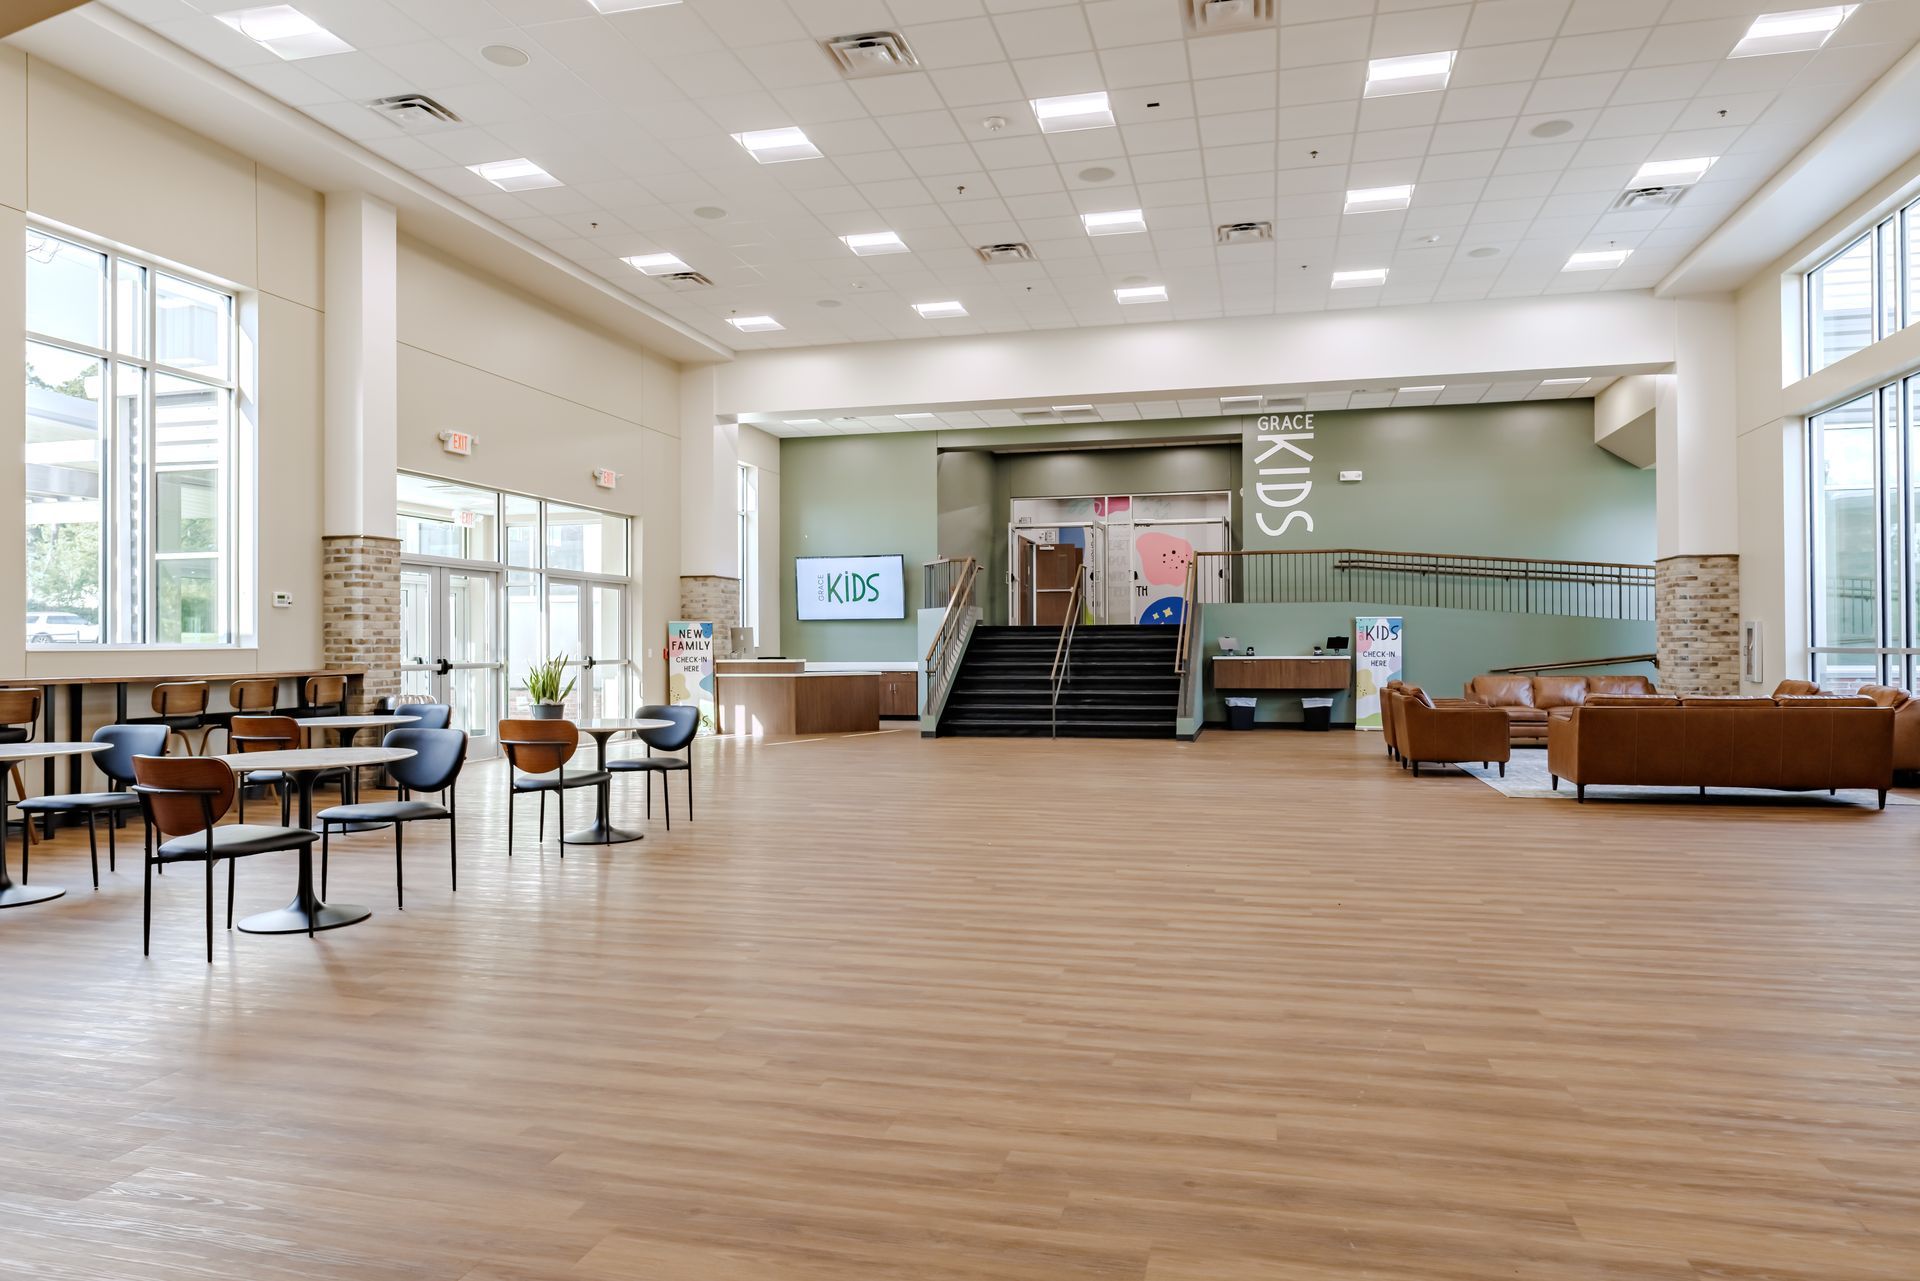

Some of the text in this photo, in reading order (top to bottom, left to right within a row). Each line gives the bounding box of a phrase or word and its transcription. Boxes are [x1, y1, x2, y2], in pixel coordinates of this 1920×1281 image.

[1257, 414, 1315, 431] GRACE
[453, 433, 468, 450] EXIT
[1254, 432, 1315, 537] KIDS
[678, 629, 703, 639] NEW
[1365, 625, 1399, 641] KIDS
[671, 640, 710, 651] FAMILY
[1362, 650, 1396, 658] CHECK-IN
[1370, 659, 1388, 667] HERE
